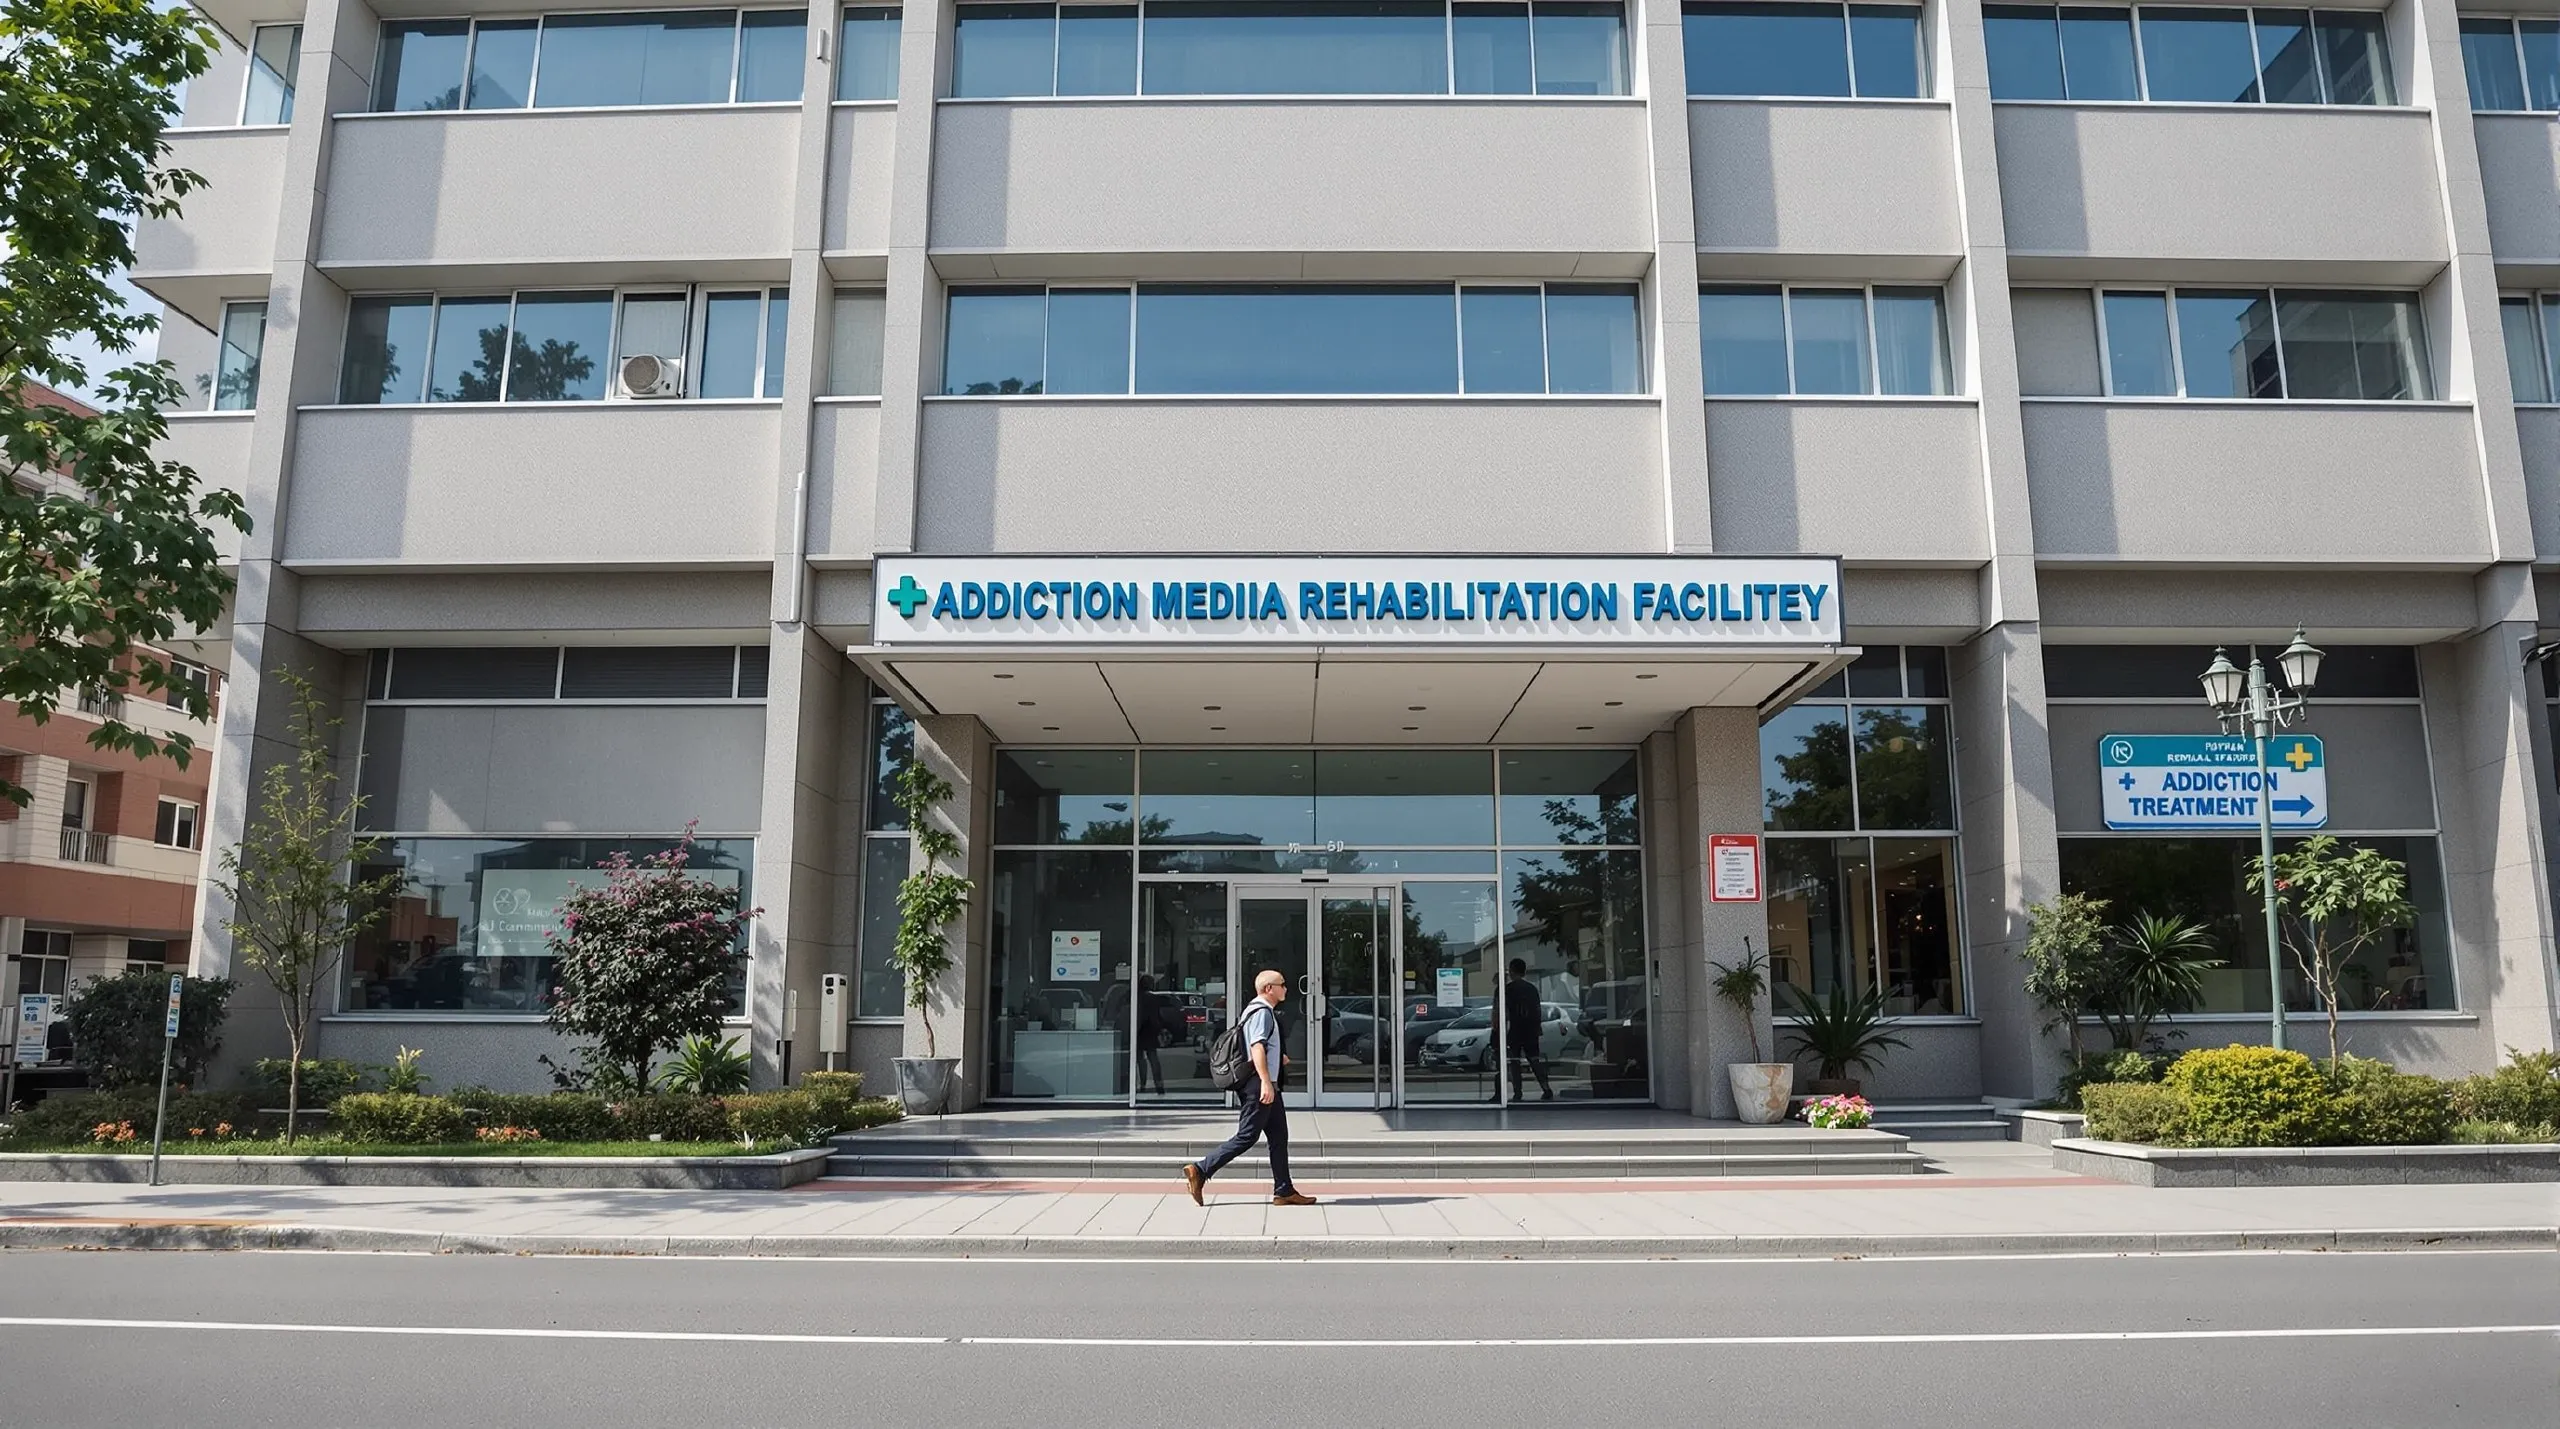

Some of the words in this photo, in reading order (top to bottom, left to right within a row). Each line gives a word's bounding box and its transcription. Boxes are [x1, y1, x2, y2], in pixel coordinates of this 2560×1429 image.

[931, 580, 1139, 620] ADDICTION
[1152, 580, 1288, 620] MEDIIA
[1299, 580, 1619, 621] REHABILITATION
[1633, 581, 1828, 621] FACILITEY
[2162, 771, 2279, 792] ADDICTION
[2129, 796, 2259, 816] TREATMENT
